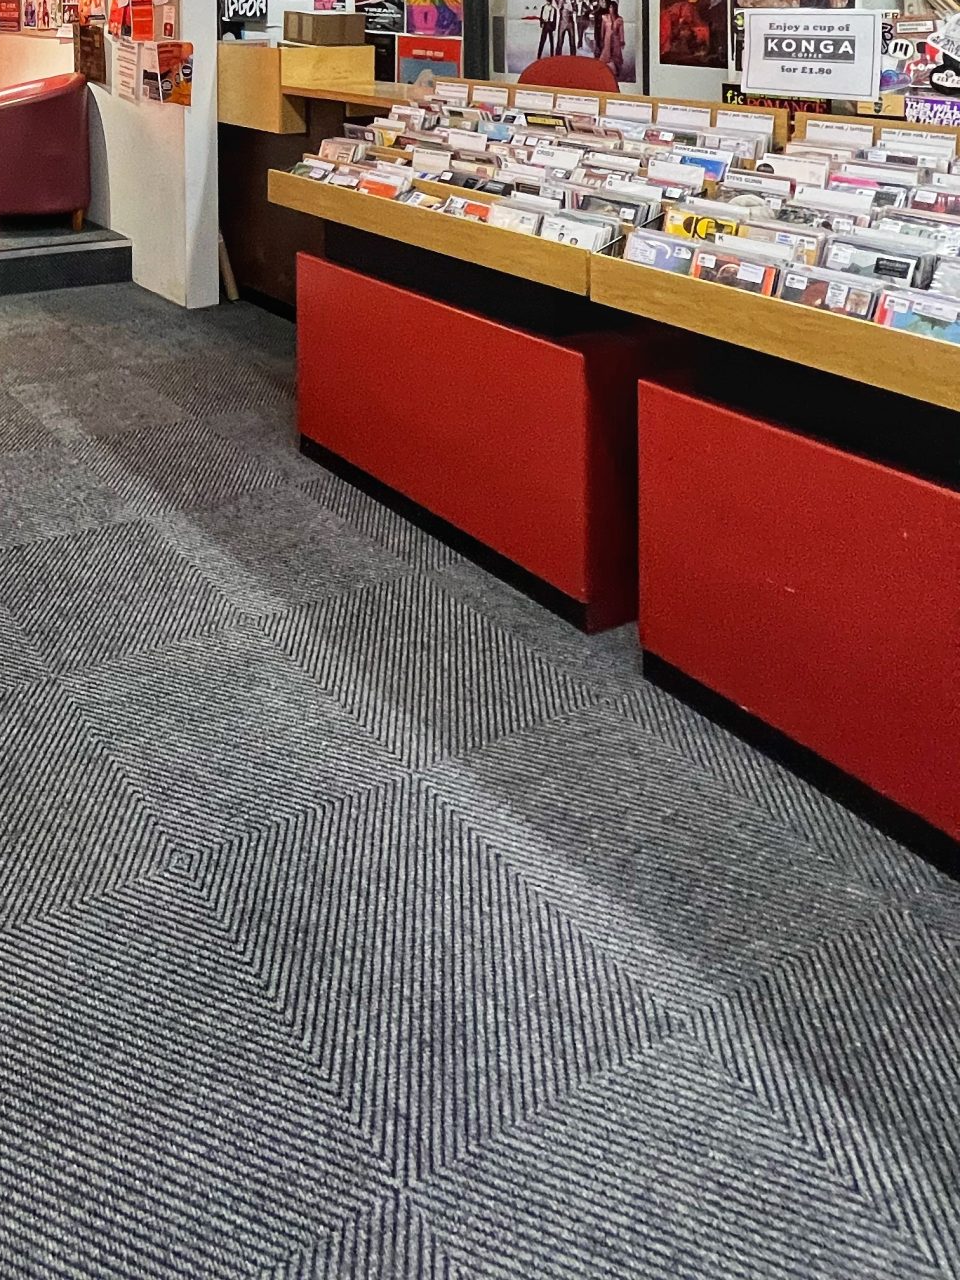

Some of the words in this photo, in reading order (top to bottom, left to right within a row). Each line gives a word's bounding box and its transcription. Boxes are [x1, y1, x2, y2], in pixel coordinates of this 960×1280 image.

[768, 22, 801, 32] Enjoy
[813, 24, 836, 33] cup
[838, 23, 851, 32] of
[767, 38, 854, 55] KONGA
[781, 65, 798, 73] for
[800, 66, 832, 75] £1.80
[675, 146, 708, 154] FONTAINES
